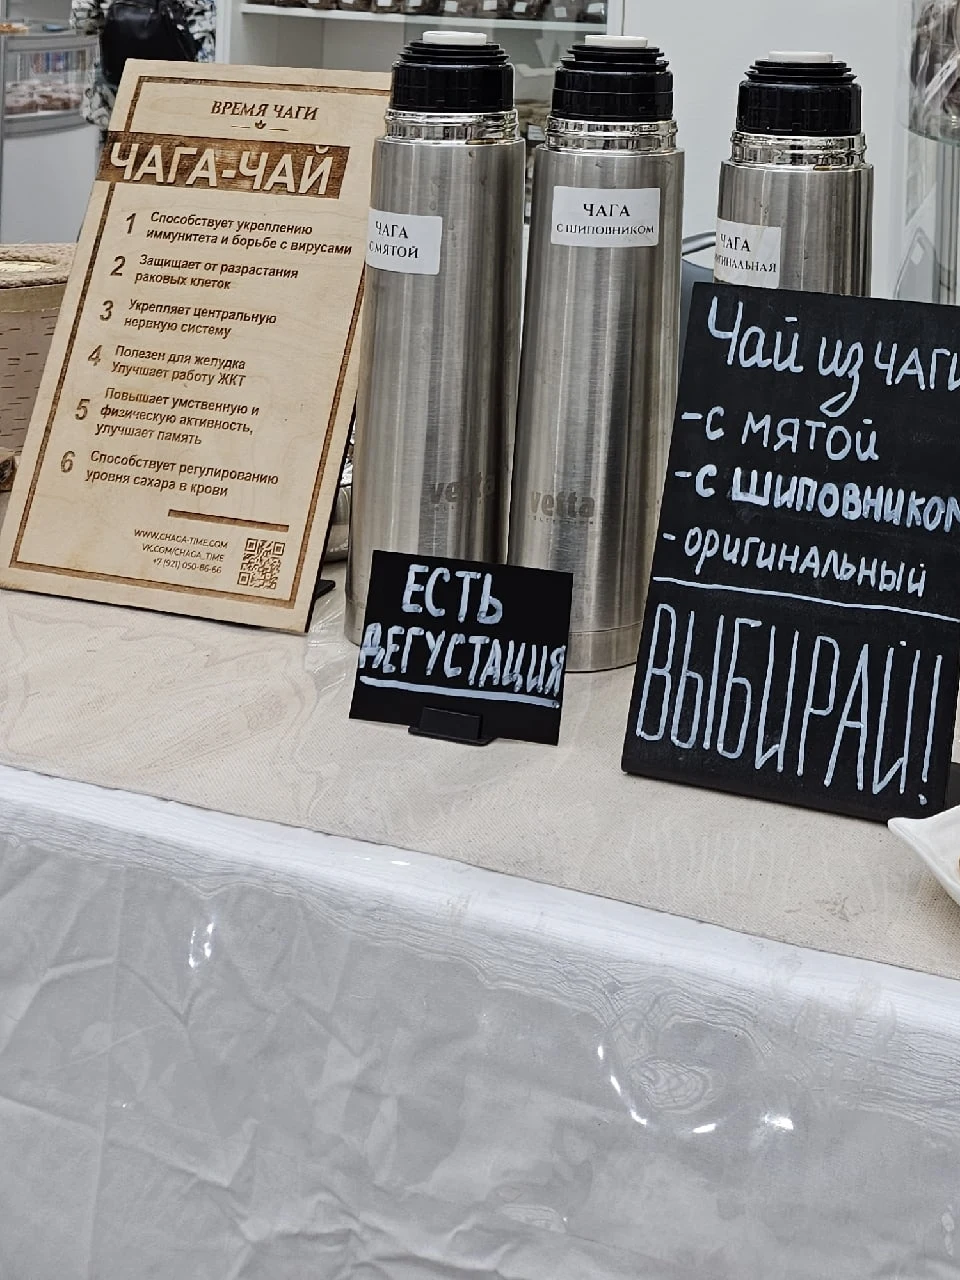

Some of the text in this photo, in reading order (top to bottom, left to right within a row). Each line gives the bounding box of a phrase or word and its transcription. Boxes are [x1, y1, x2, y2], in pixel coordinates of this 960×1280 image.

[211, 100, 319, 121] ВРЕМЯ ЧАГИ
[110, 142, 334, 195] ЧАГА-ЧАЙ
[583, 203, 630, 217] ЧАГА
[126, 211, 313, 236] 1 Способствует укреплению
[375, 221, 408, 239] ЧАГА
[565, 223, 654, 236] ШИПОВНИКОМ
[146, 228, 353, 257] иммунитета и борьбе с вирусами
[375, 244, 419, 259] МЯТОЙ
[720, 233, 751, 252] ЧАГА
[110, 254, 299, 279] 2 Защищает от разрастания
[134, 272, 231, 290] раковых клеток
[100, 299, 277, 325] 3 Укрепляет центральную
[124, 318, 232, 339] нервную систему
[88, 345, 246, 370] 4 Полезен для желудка
[706, 295, 805, 375] Чай
[818, 336, 864, 416] из
[111, 361, 246, 387] Улучшает работу ЖКТ
[75, 388, 260, 420] 5 Повышает умственную и
[100, 405, 253, 435] физическую активность,
[95, 423, 202, 445] улучшает память
[61, 450, 279, 485] 6 Способствует регулированию
[85, 469, 229, 497] уровня сахара в крови
[531, 491, 596, 518] vetta
[400, 563, 504, 626] ЕСТЬ
[359, 622, 566, 695] ДЕГУСТАЦИЯ
[634, 603, 944, 807] ВЫБИРАЙ!
